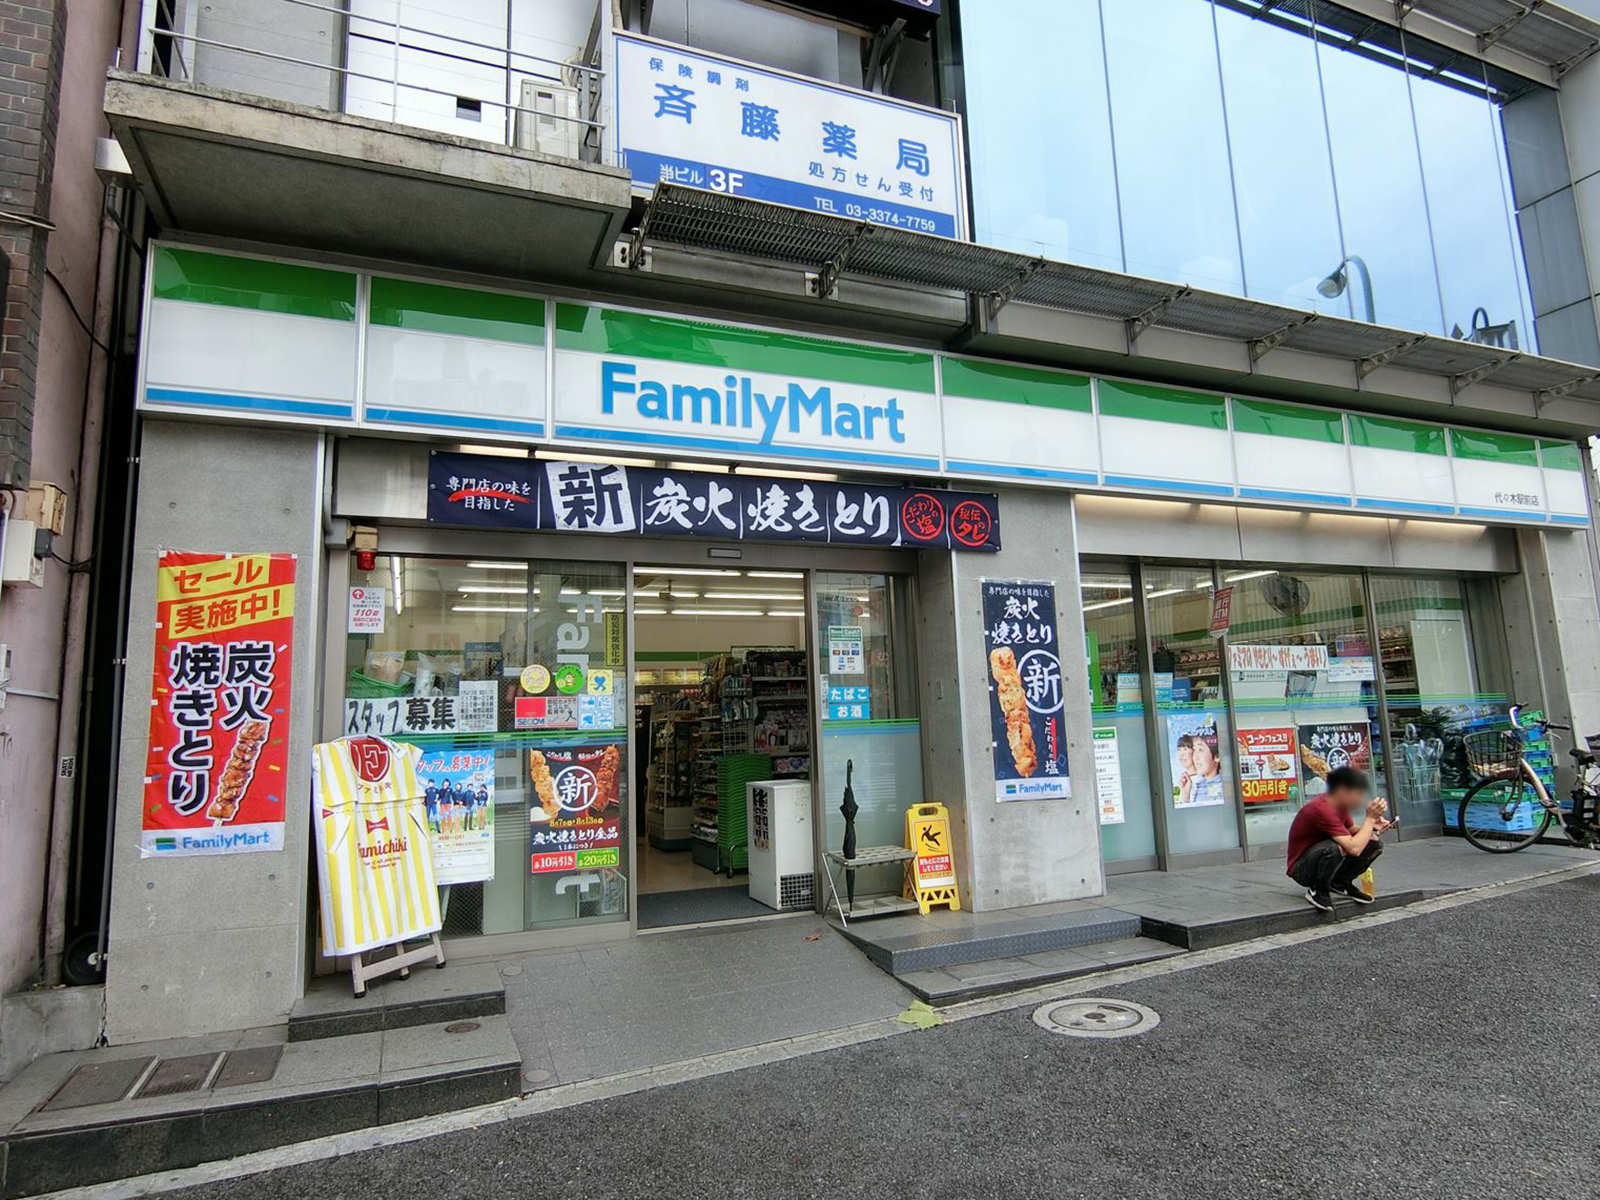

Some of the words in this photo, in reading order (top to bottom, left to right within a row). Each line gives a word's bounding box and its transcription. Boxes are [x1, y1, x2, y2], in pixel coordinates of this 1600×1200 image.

[649, 57, 750, 92] 保険調剤
[653, 82, 931, 177] 斉藤薬局
[659, 163, 703, 185] 当ビル
[709, 169, 745, 195] 3F
[808, 161, 934, 202] 処方せん受付
[813, 196, 839, 215] TEL
[845, 203, 936, 232] 03-3374-7759
[601, 360, 906, 445] FamilyMart
[446, 475, 532, 497] 専門店の味を
[558, 464, 623, 529] 新
[1494, 492, 1539, 506] 代々木駅前店
[464, 496, 516, 512] 目指した
[174, 559, 263, 594] セール
[174, 589, 280, 634] 実施中!
[1003, 595, 1040, 620] 炭火
[991, 620, 1052, 645] 焼きとり
[222, 642, 274, 729] 炭火
[830, 687, 867, 700] たばこ
[1023, 658, 1060, 705] 新
[517, 717, 545, 726] SECOM
[837, 705, 862, 718] お酒
[171, 643, 221, 813] 焼きとり
[1310, 731, 1362, 749] 炭火焼きとり
[357, 782, 392, 794] ファミチキ
[559, 772, 593, 804] 新
[1018, 782, 1063, 793] FamilyMart
[1241, 779, 1288, 797] 30円引き
[182, 831, 269, 849] FamilyMart
